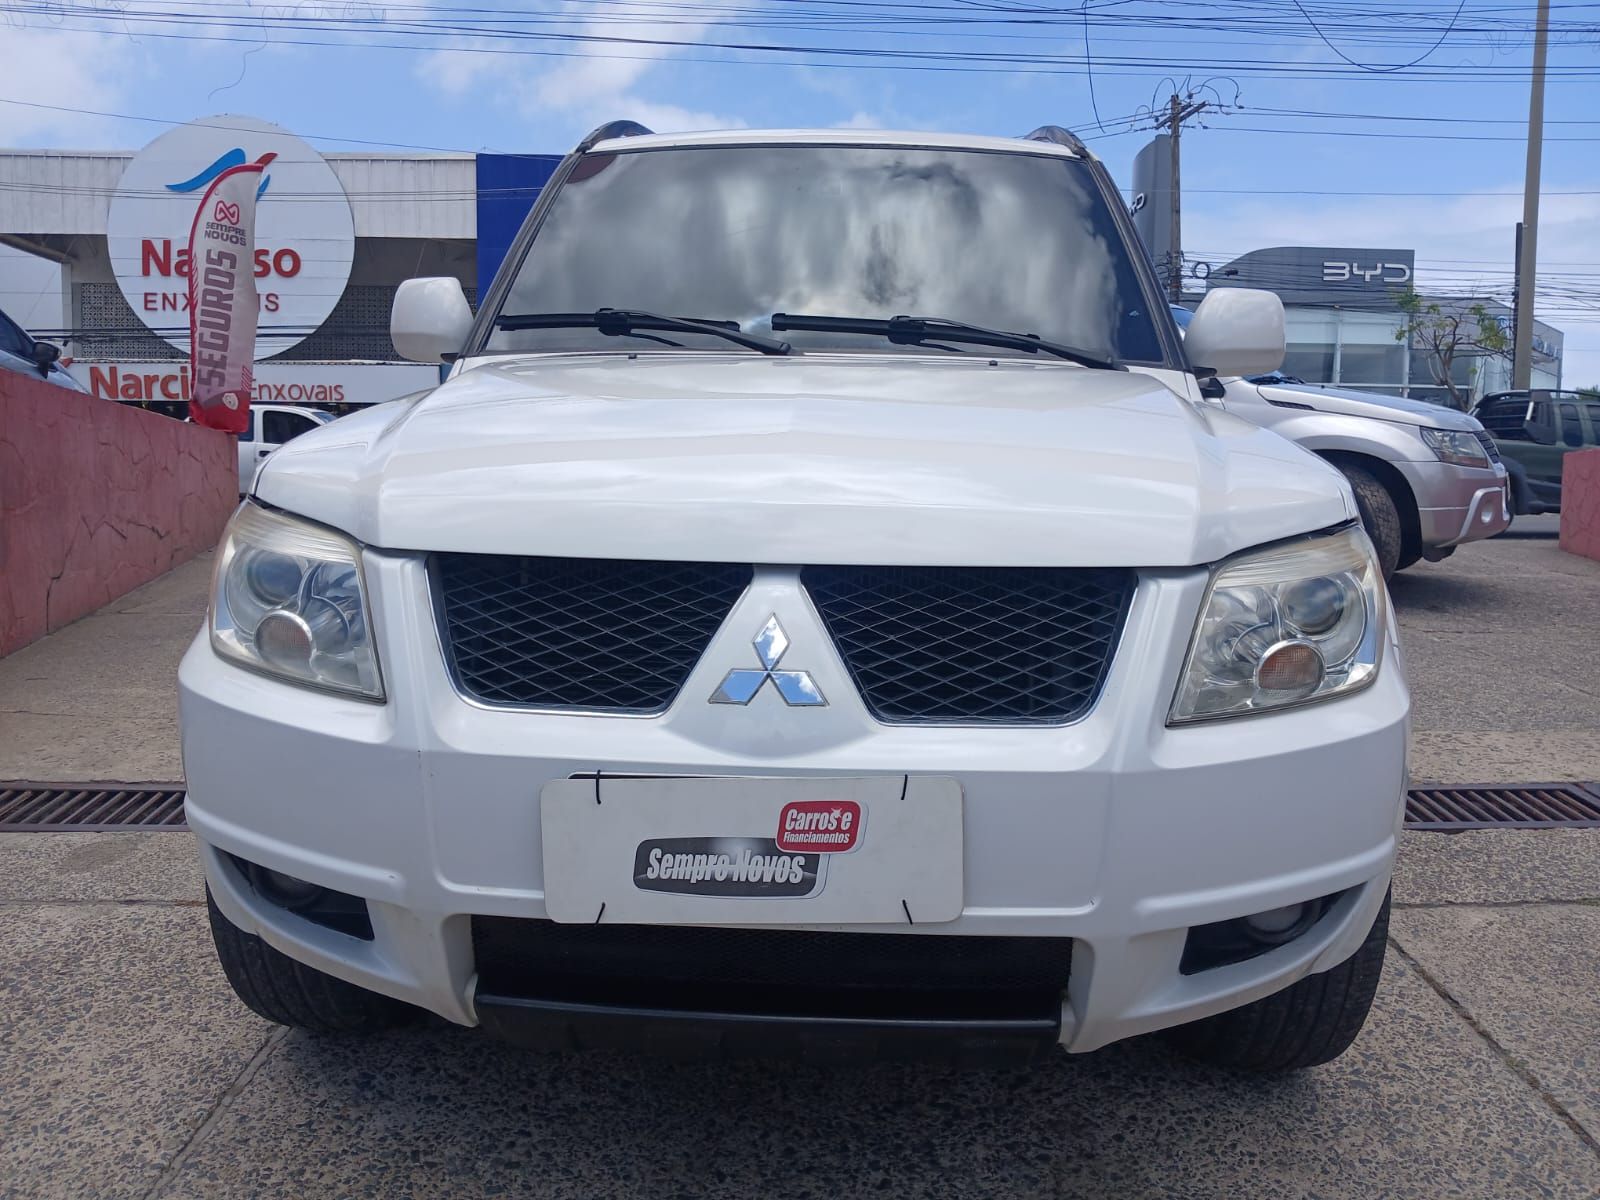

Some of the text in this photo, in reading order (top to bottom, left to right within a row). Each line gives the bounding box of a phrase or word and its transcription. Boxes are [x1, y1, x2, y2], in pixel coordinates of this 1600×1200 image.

[205, 221, 247, 237] SEMPRE
[142, 240, 302, 277] Naso
[1323, 261, 1411, 283] BYD
[197, 248, 237, 388] SEGUROS
[89, 366, 191, 400] Narci
[785, 808, 853, 831] Carros e
[783, 831, 851, 844] Financiamentos
[732, 849, 806, 884] Novos
